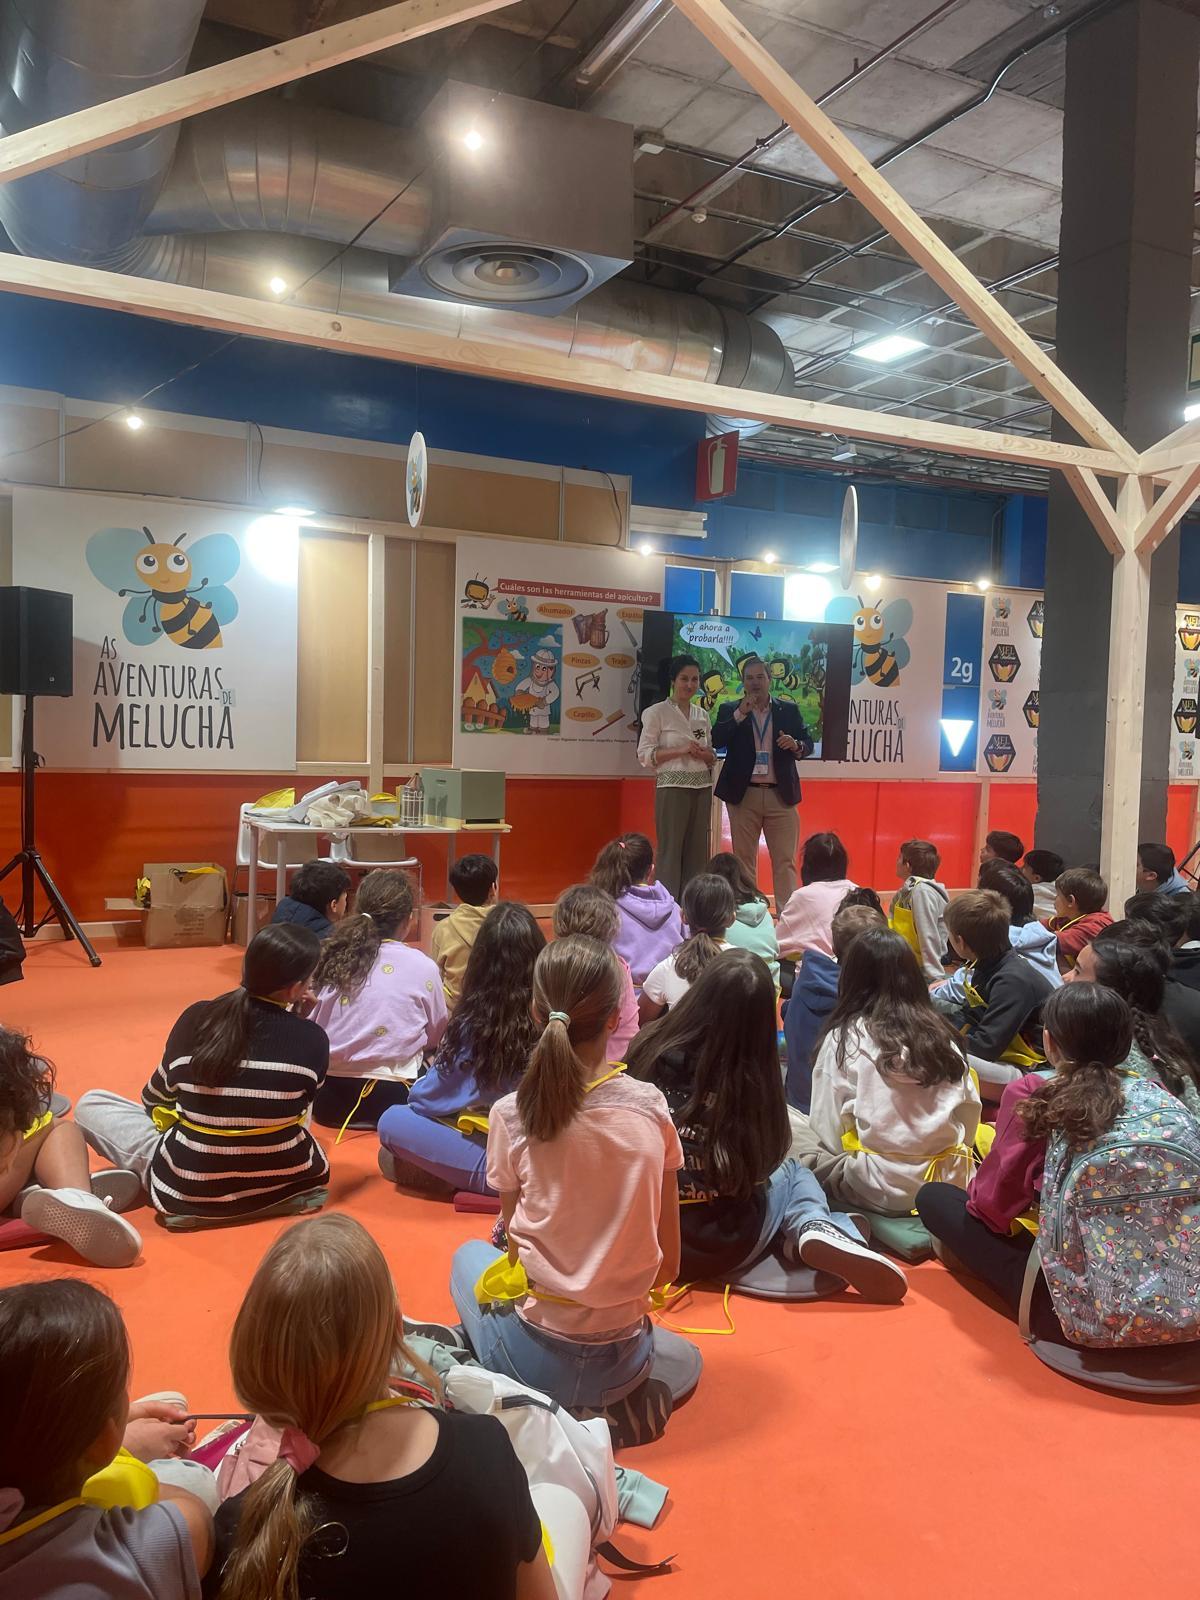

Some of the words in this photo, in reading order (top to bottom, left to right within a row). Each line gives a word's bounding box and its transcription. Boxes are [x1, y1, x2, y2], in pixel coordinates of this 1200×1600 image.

[500, 582, 525, 592] Cuáles
[542, 585, 553, 594] las
[554, 587, 603, 599] herramientas
[605, 592, 616, 600] del
[617, 593, 653, 603] apicultor?
[539, 606, 573, 616] Ahumador
[699, 622, 723, 632] ahora
[101, 635, 117, 660] AS
[571, 657, 591, 665] Pinzas
[611, 657, 627, 666] Traje
[951, 656, 973, 683] 2g
[93, 661, 224, 701] AVENTURAS
[222, 690, 233, 705] DE
[849, 699, 900, 726] NTURAS
[92, 702, 234, 750] MELUCHA
[844, 729, 904, 763] ELUCHA
